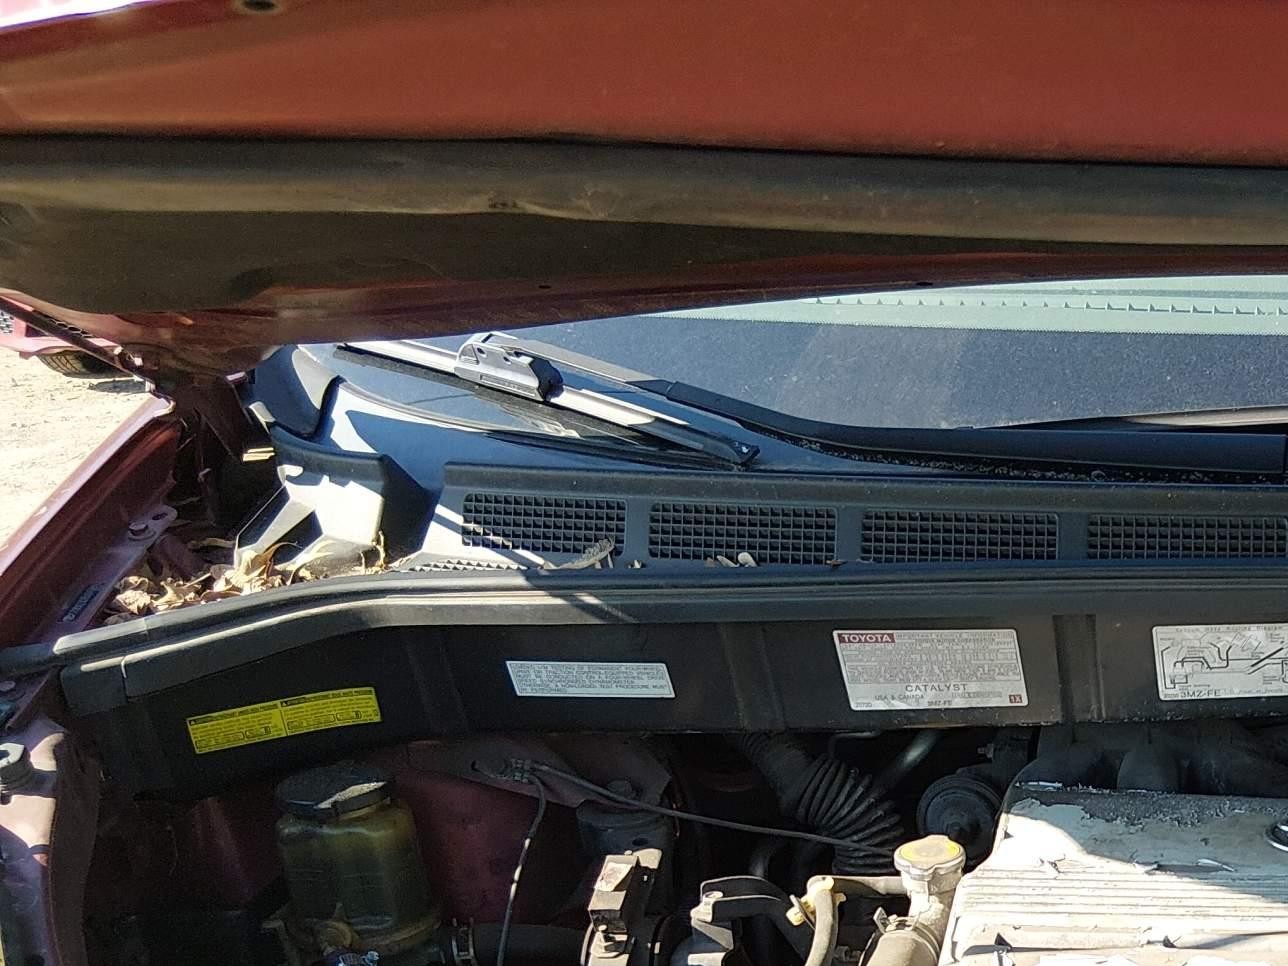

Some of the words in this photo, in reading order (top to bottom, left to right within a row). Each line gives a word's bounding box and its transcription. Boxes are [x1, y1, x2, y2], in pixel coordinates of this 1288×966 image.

[842, 633, 892, 643] TOYOTA
[905, 683, 968, 693] CATALYST
[1180, 689, 1222, 698] 3MZ-FE
